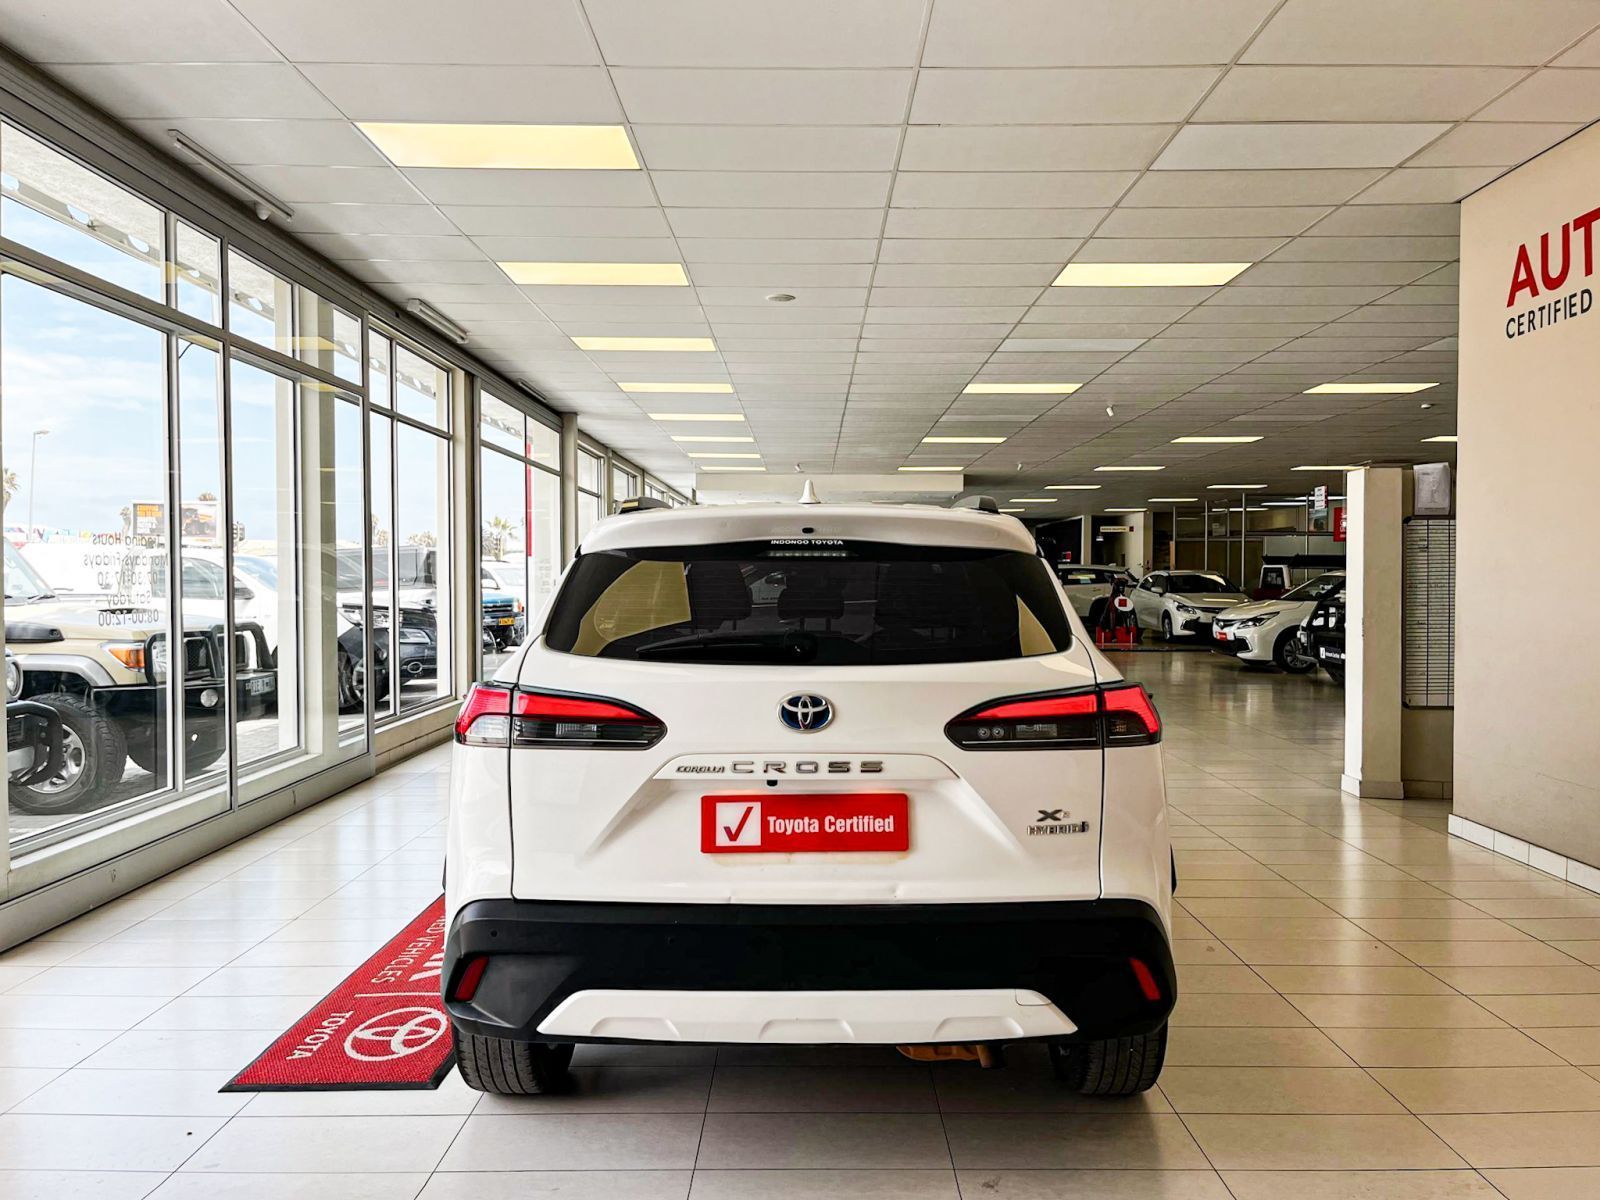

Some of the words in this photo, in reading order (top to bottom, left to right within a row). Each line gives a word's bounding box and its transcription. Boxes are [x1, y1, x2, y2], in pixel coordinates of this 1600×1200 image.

[1505, 288, 1593, 339] CERTIFIED
[676, 765, 725, 774] COROLLA
[731, 760, 884, 774] CROSS
[767, 816, 819, 835] Toyota
[824, 814, 894, 833] Certified
[1027, 824, 1081, 836] HYBRID
[370, 934, 440, 983] VEHICLES
[285, 1010, 354, 1060] TOYOTA
